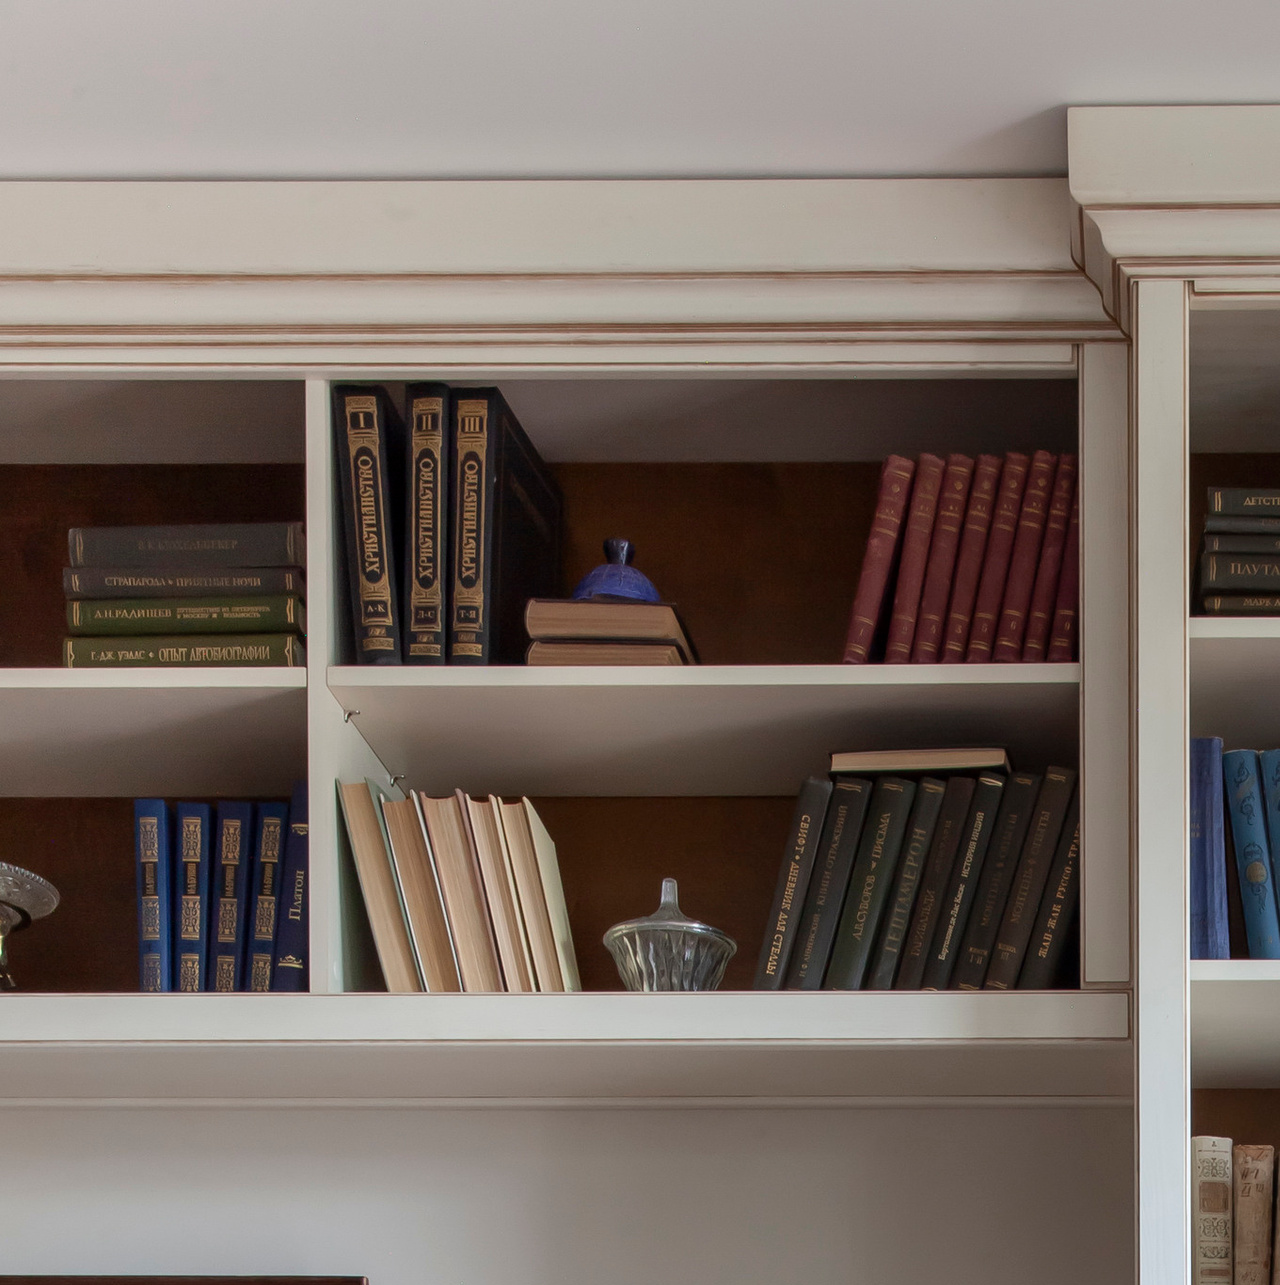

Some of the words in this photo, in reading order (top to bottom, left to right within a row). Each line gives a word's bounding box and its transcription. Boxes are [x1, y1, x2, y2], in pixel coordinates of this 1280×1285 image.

[422, 415, 432, 430] II
[465, 417, 480, 432] III
[357, 455, 381, 575] ХРИСТИАНСТВО
[419, 457, 435, 579] ХРИСТИАНСТВО
[462, 460, 479, 580] ХРИСТИАНСТВО
[159, 648, 187, 662] ОПЫТ
[189, 646, 270, 662] АВТОБИОГРАФИИ
[794, 813, 811, 854] СВИФТ
[871, 812, 891, 859] ПИСЬМА
[289, 869, 304, 921] Платон
[781, 861, 800, 910] ДНЕВНИК
[883, 827, 927, 953] ГЕПТАМЕРОН
[776, 911, 788, 933] ДЛЯ
[1038, 904, 1061, 958] ЖАН-ЖАК
[1056, 866, 1072, 899] РУССО
[766, 933, 783, 976] СТЕЛЛЫ
